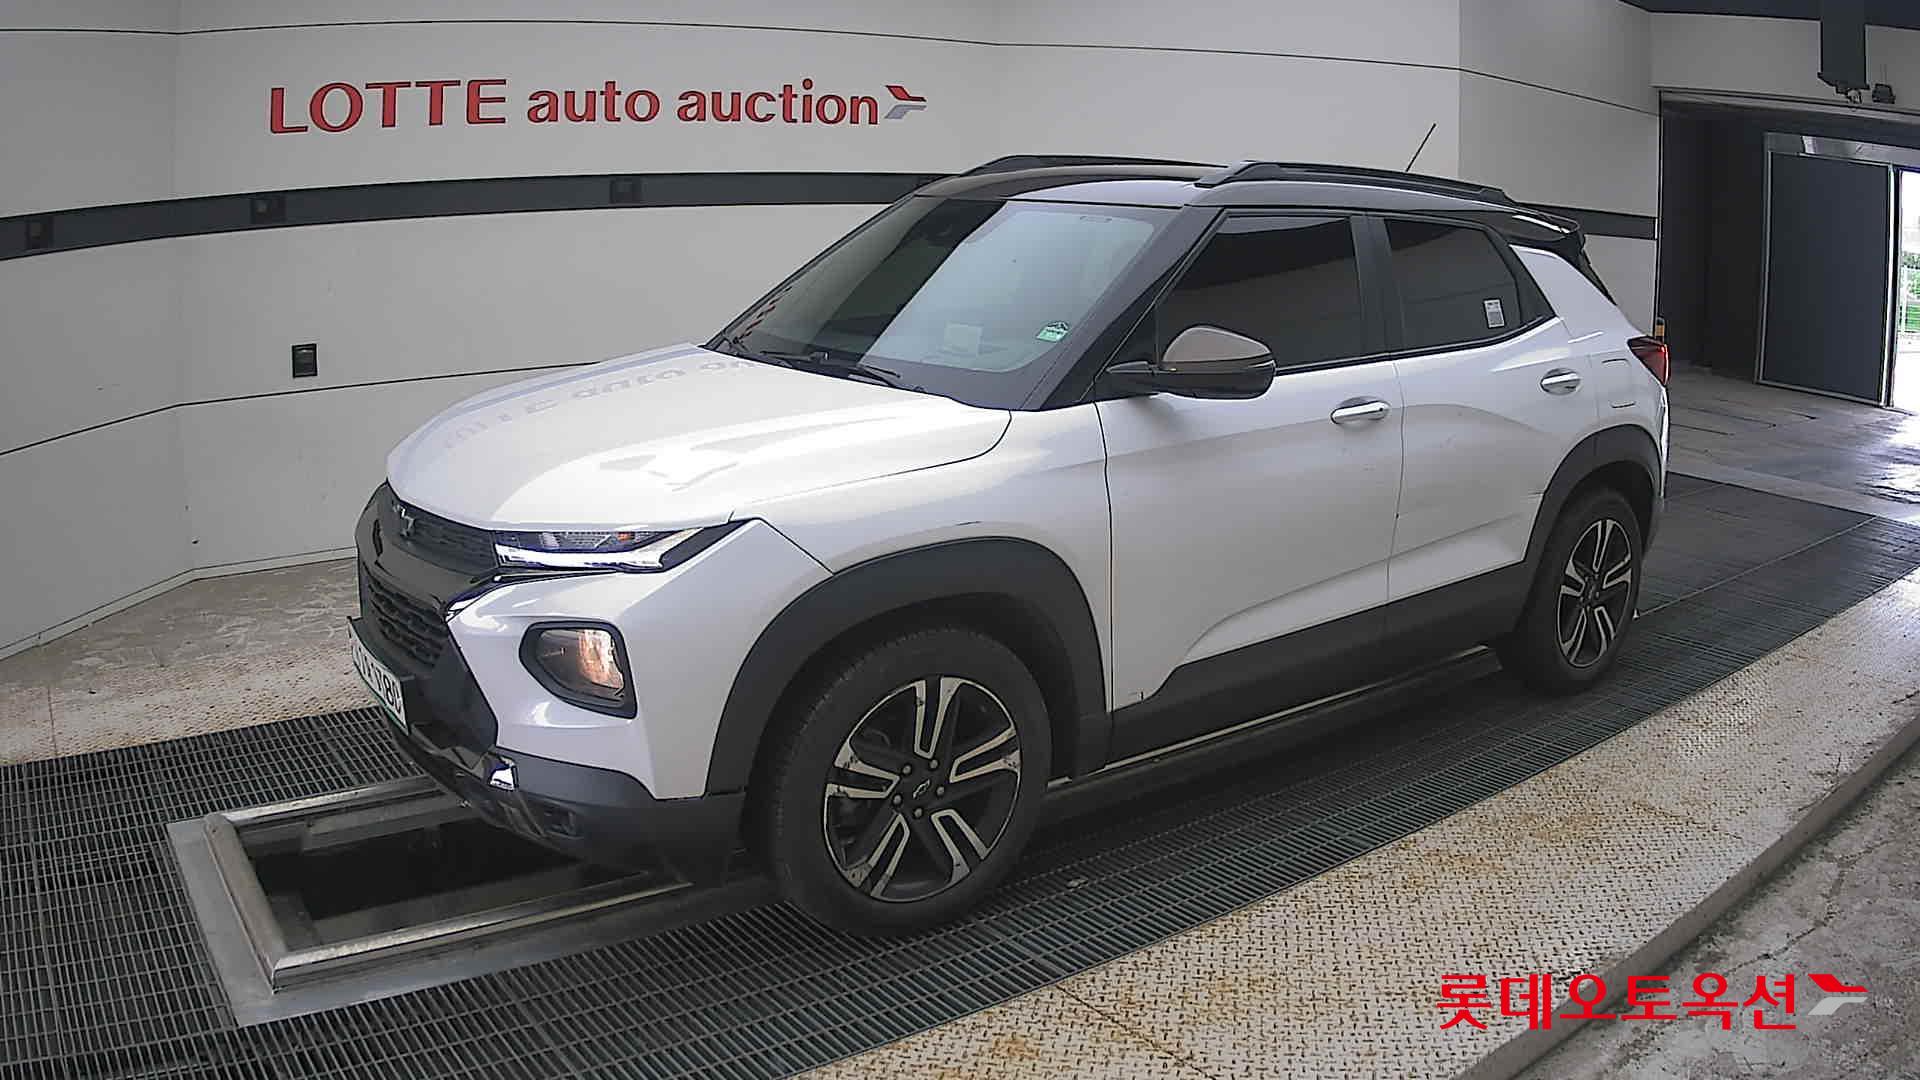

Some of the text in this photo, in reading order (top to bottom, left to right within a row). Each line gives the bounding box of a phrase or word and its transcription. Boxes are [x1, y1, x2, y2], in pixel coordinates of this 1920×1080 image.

[271, 79, 879, 134] LOTTE auto auction
